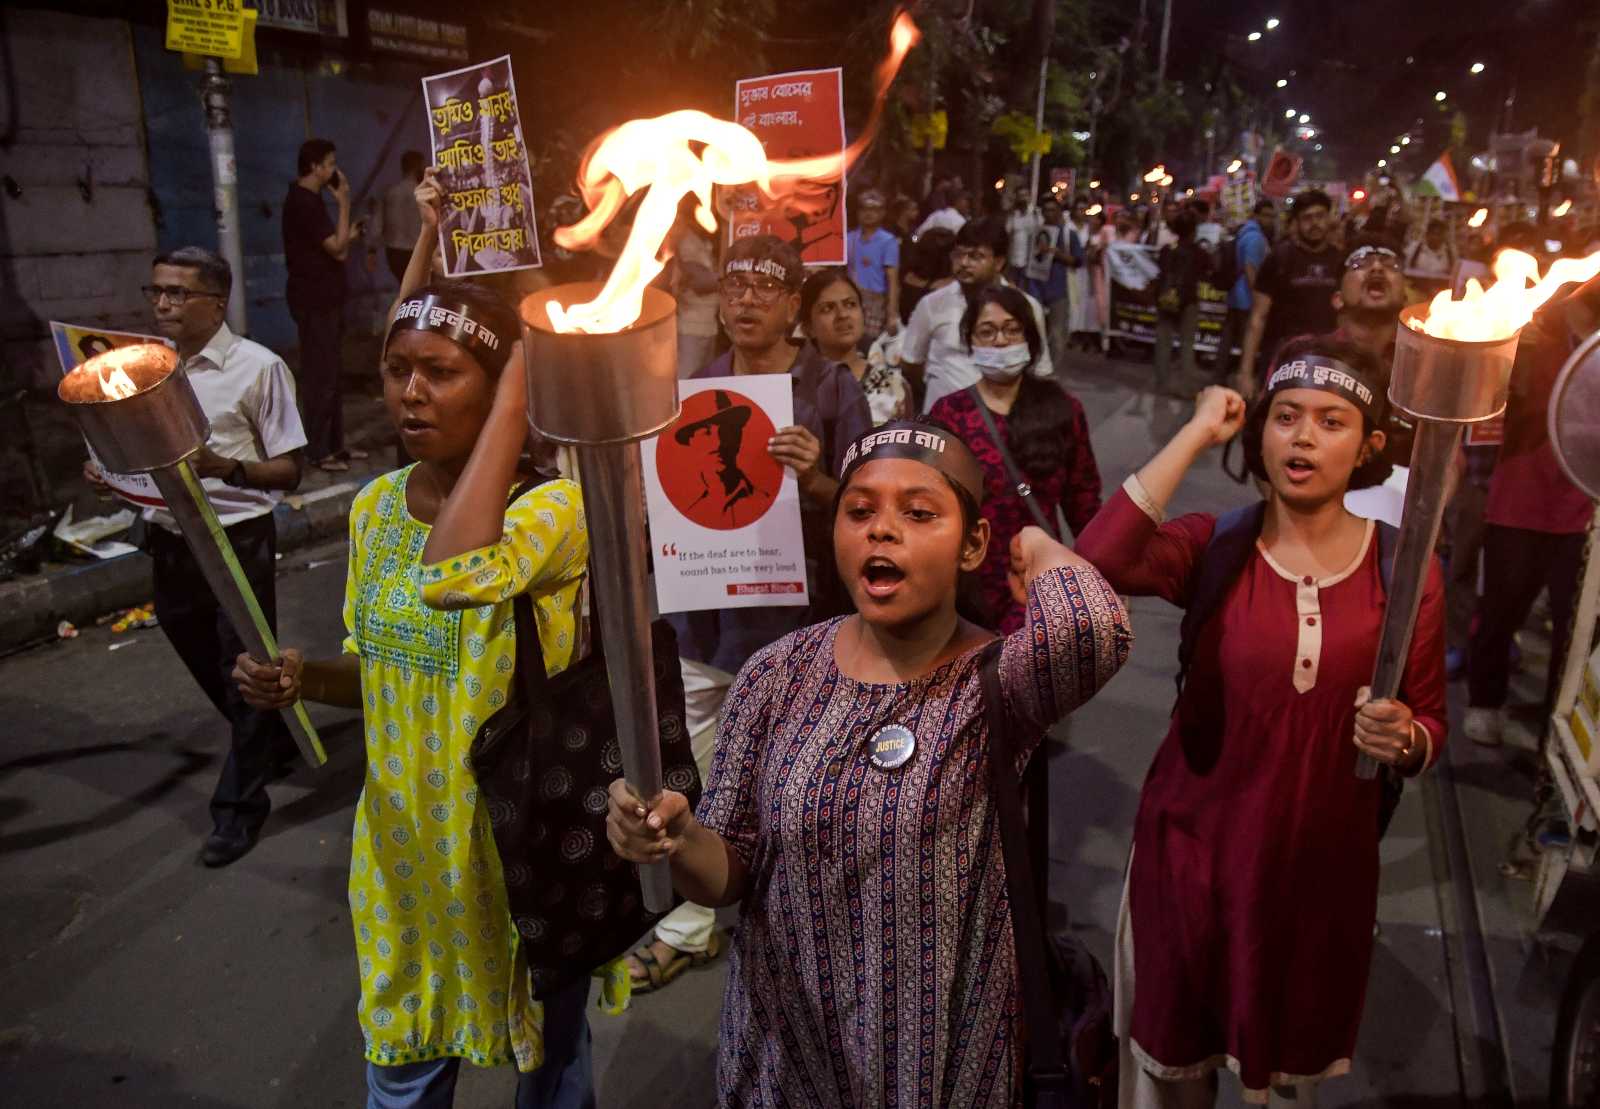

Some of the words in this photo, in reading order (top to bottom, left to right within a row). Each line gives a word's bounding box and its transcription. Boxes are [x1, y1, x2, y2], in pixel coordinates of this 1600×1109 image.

[432, 97, 473, 135] তুমিও
[436, 140, 485, 169] আমিও
[755, 259, 786, 280] JUSTICE
[429, 306, 478, 335] ভুলব
[1313, 366, 1357, 392] ভুলব
[861, 429, 912, 456] ভুলব
[689, 550, 705, 561] the
[707, 548, 727, 559] deaf
[730, 549, 746, 558] are
[746, 549, 757, 557] to
[680, 566, 709, 577] sound
[711, 564, 727, 576] has
[729, 565, 739, 574] to
[741, 563, 752, 573] be
[753, 564, 774, 575] very
[875, 738, 905, 753] JUSTICE
[870, 754, 883, 767] FOR
